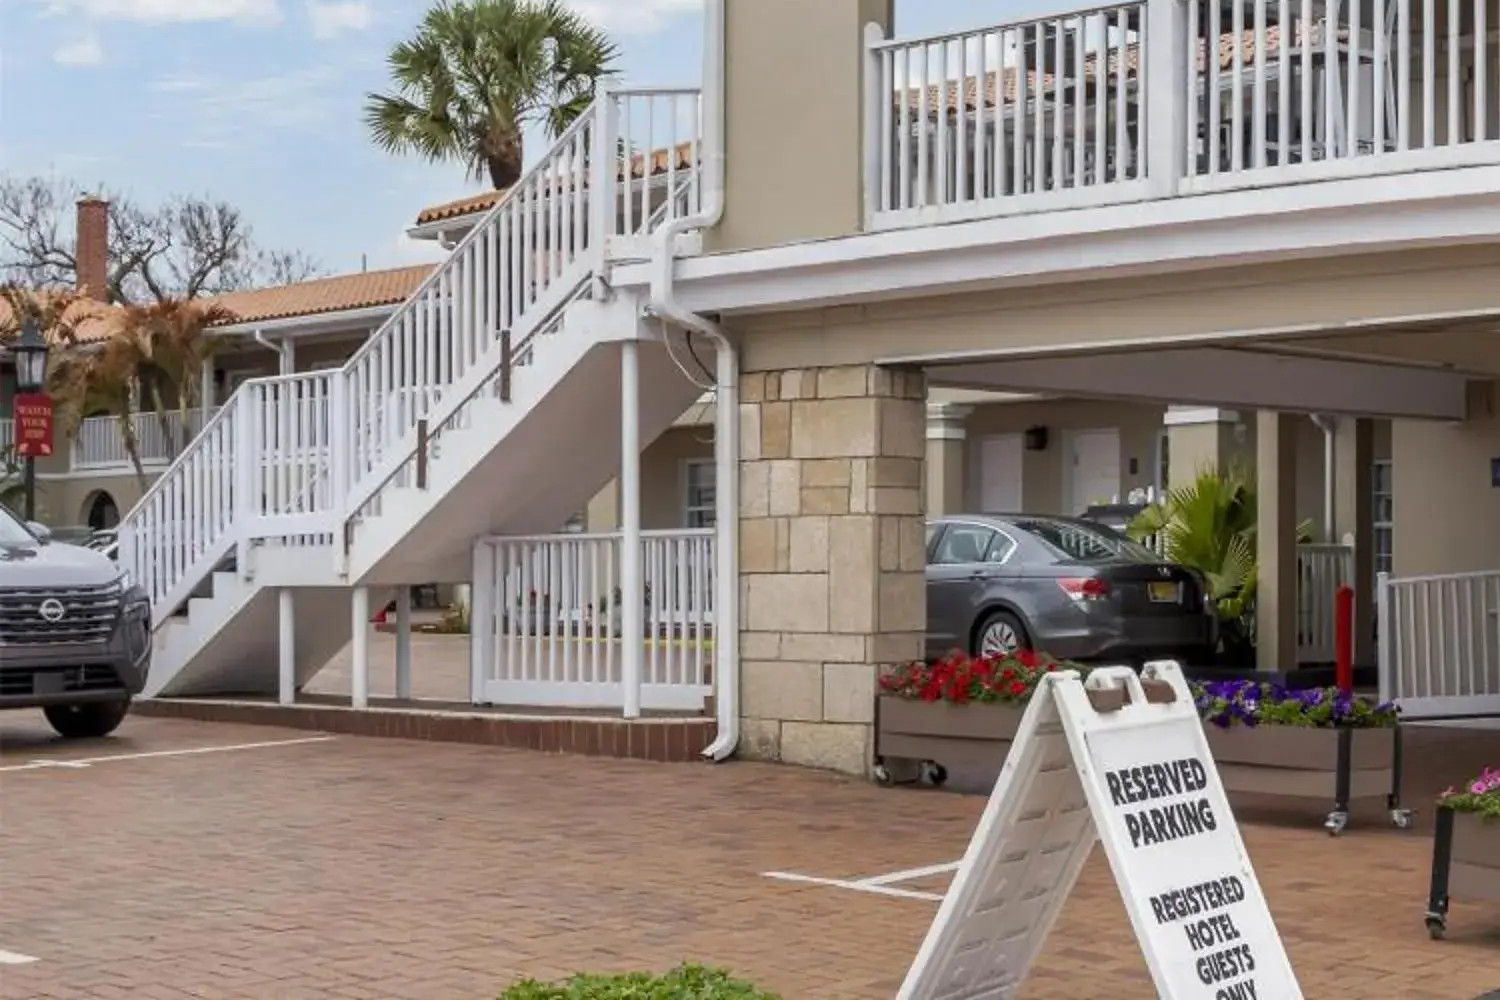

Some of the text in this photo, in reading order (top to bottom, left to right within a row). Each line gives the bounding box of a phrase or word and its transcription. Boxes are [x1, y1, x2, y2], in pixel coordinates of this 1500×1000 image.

[1105, 757, 1206, 806] RESERVED
[1124, 798, 1217, 848] PARKING
[1150, 875, 1245, 924] REGISTERED
[1184, 913, 1240, 951] HOTEL
[1196, 944, 1255, 985] GUESTS
